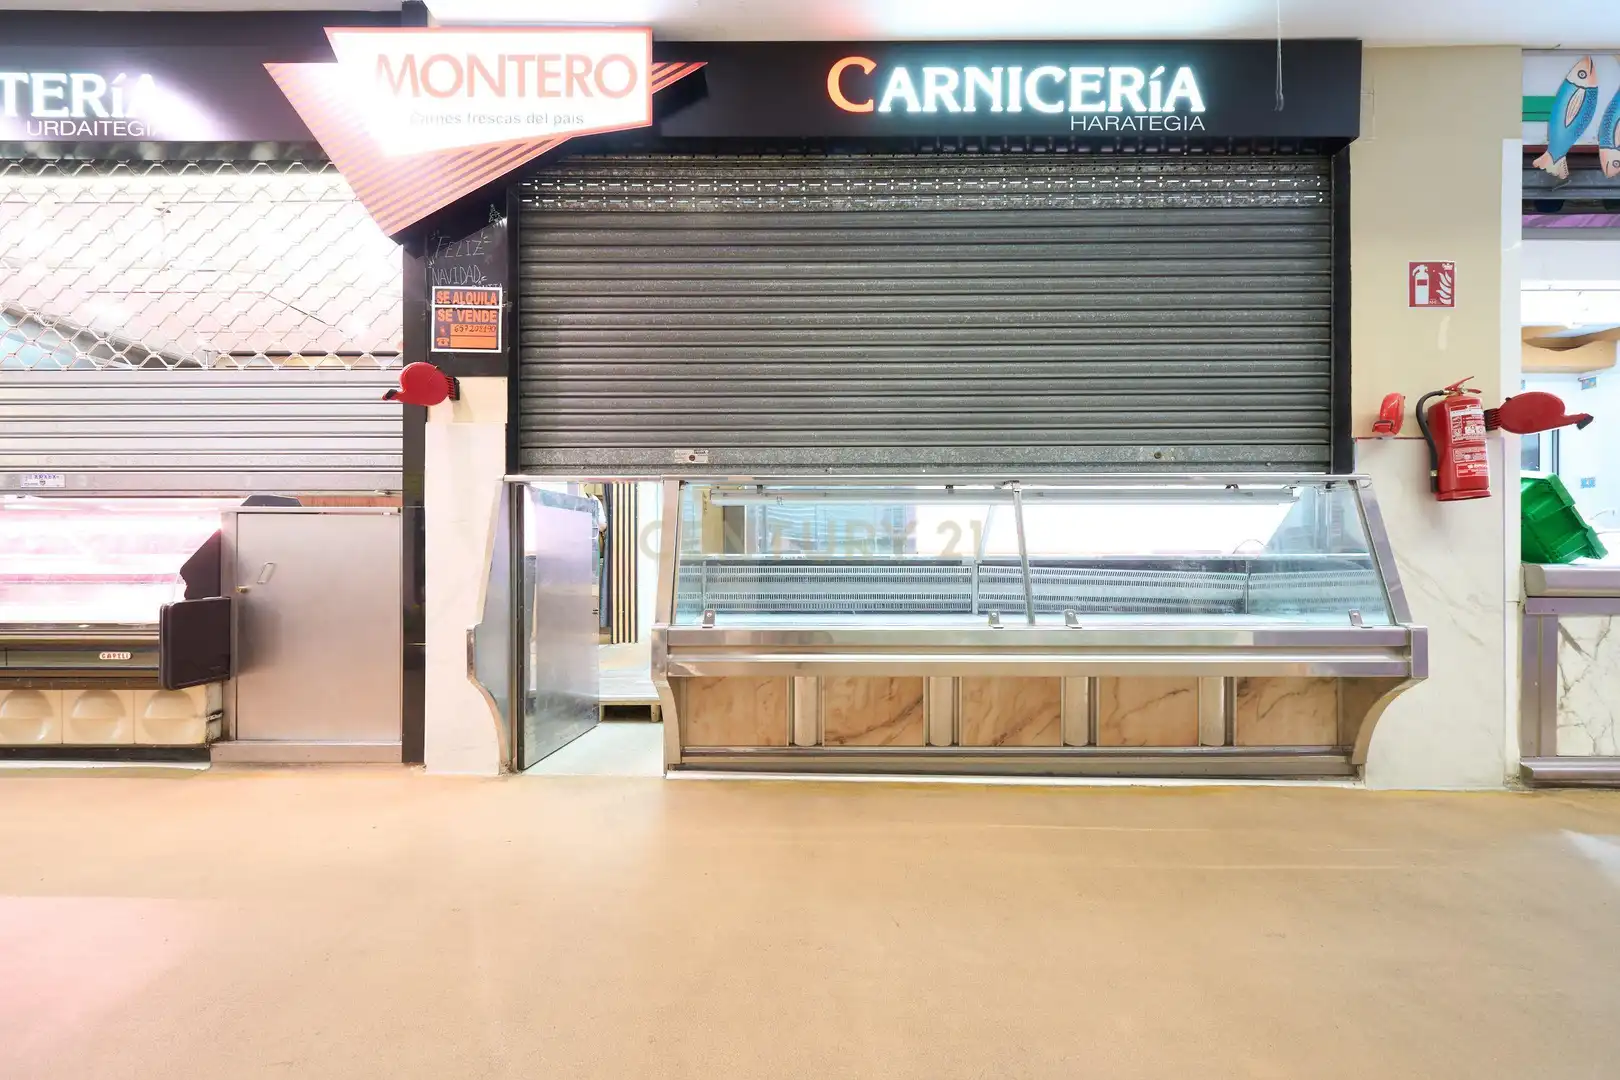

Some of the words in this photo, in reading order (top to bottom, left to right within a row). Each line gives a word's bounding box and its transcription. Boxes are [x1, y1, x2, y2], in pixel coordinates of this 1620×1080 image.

[376, 53, 638, 98] MONTERO
[467, 111, 521, 125] frescas
[526, 111, 548, 125] del
[1070, 115, 1206, 131] HARATEGIA
[26, 120, 158, 136] URDAITEGI
[435, 235, 485, 258] FELIZ
[432, 264, 482, 286] NAVIDAD
[436, 291, 450, 304] SE
[452, 291, 498, 305] ALQUILA
[437, 308, 453, 322] SE
[456, 309, 498, 322] VENDE
